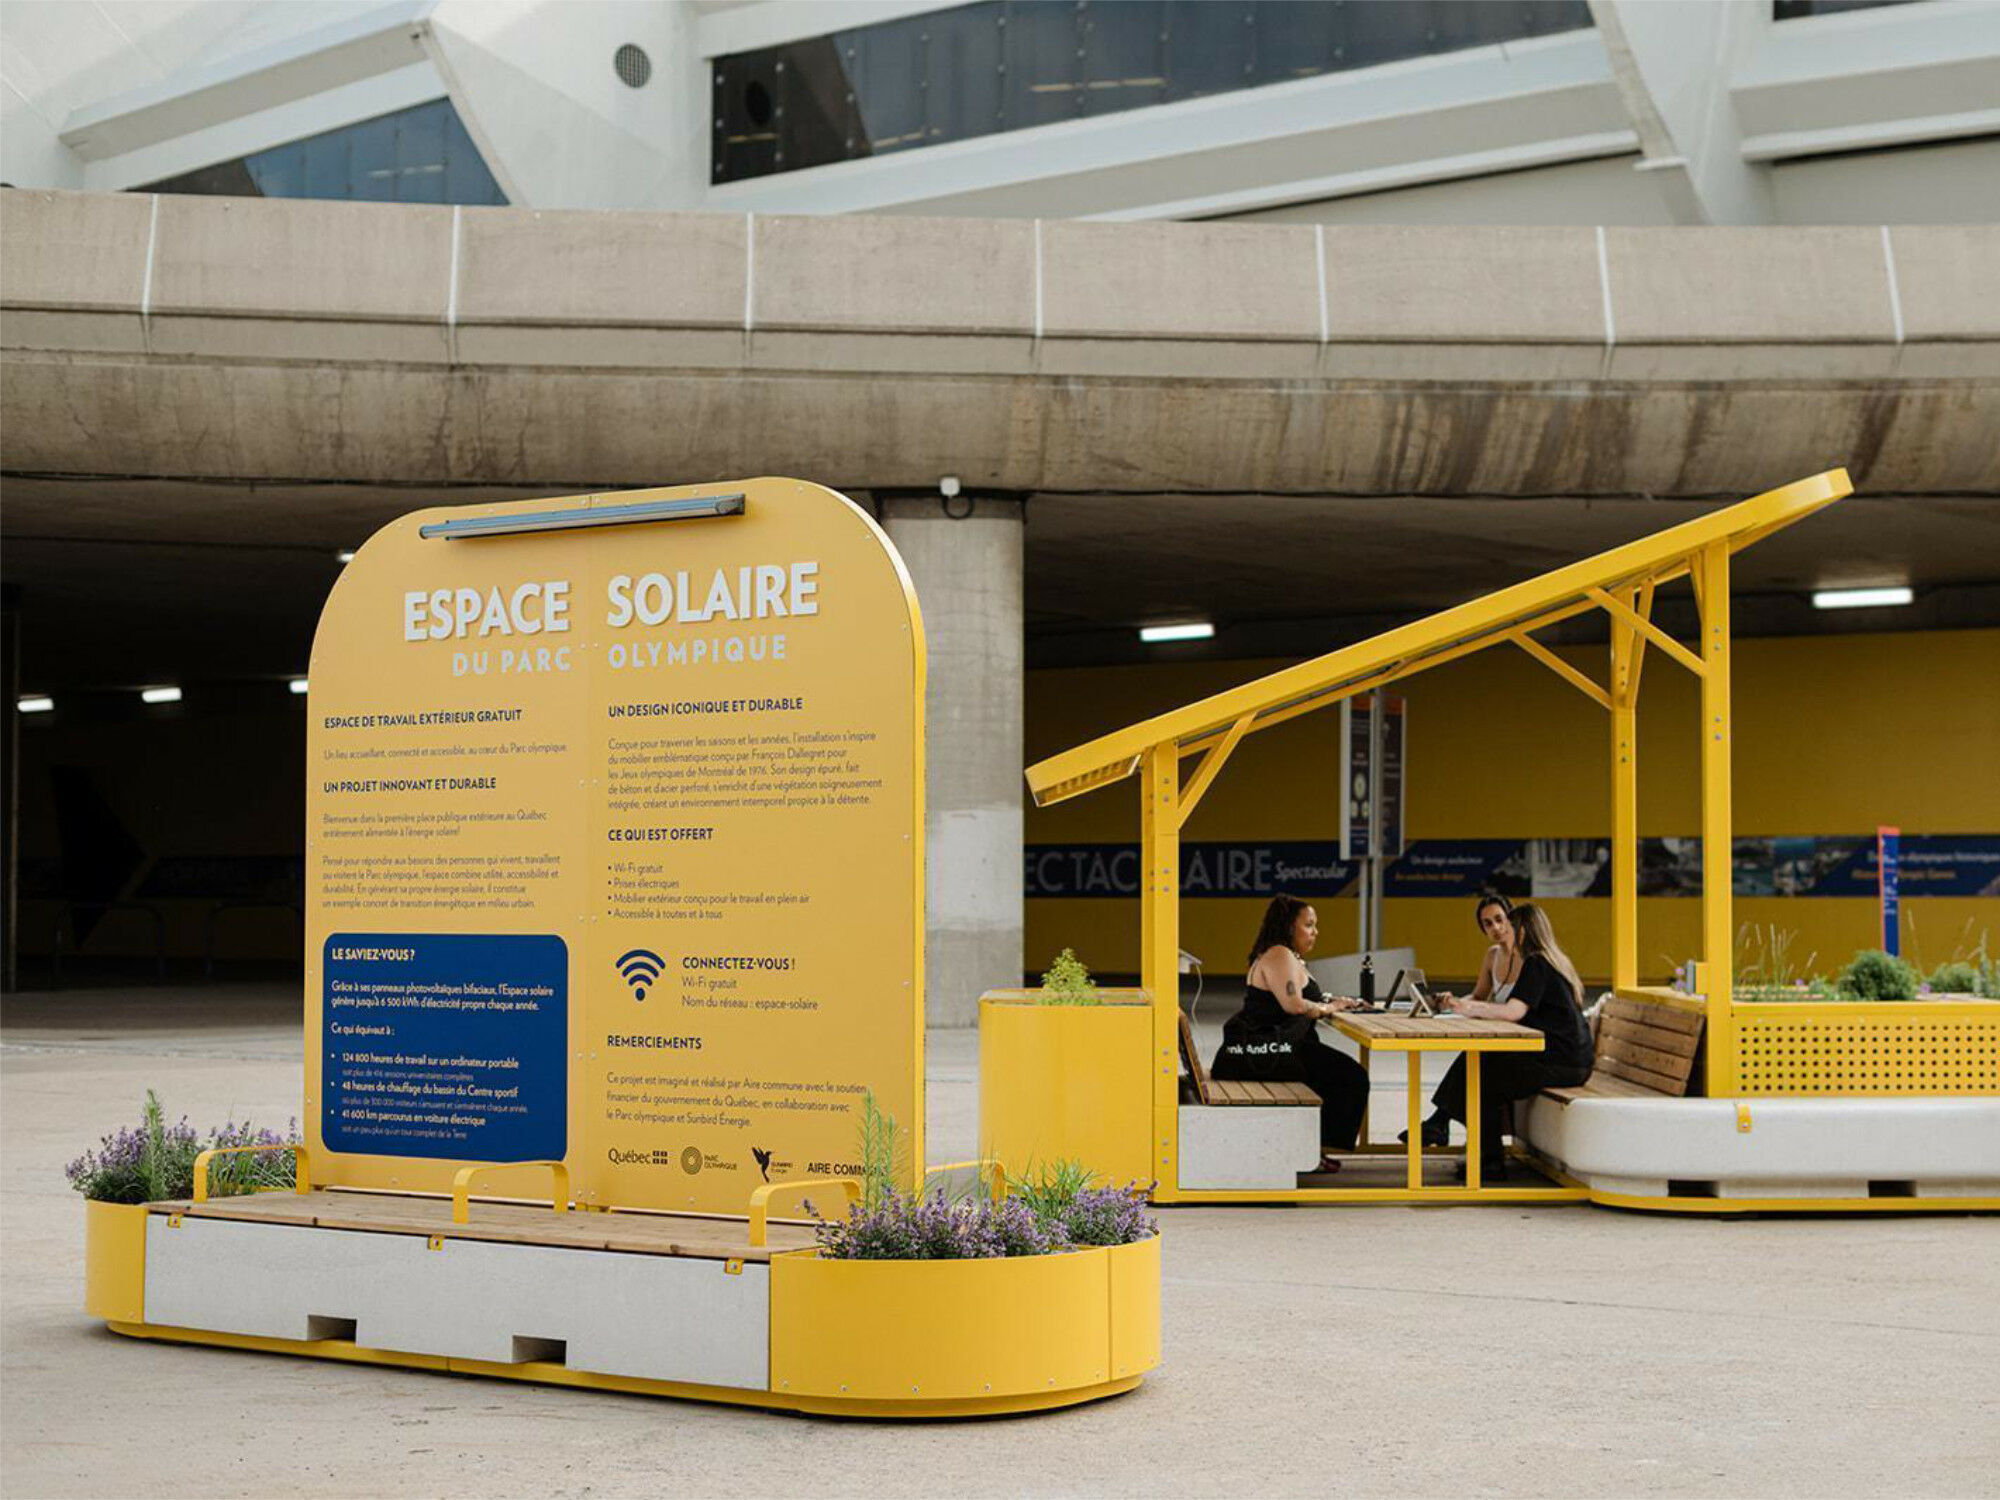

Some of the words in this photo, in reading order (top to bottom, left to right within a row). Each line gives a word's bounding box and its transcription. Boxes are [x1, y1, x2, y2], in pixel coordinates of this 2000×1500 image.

[404, 580, 571, 643] ESPACE
[606, 562, 819, 628] SOLAIRE
[452, 653, 489, 677] DU
[500, 646, 572, 674] PARC
[607, 634, 788, 670] OLYMPIQUE
[608, 705, 625, 717] UN
[627, 703, 669, 717] DESIGN
[671, 701, 729, 715] ICONIQUE
[731, 700, 746, 713] ET
[748, 698, 804, 712] DURABLE
[324, 716, 360, 729] ESPACE
[362, 715, 375, 727] DE
[378, 714, 418, 726] TRAVAIL
[419, 711, 475, 725] EXTÉRIEUR
[477, 709, 523, 723] GRATUIT
[324, 781, 339, 793] UN
[340, 780, 377, 792] PROJET
[379, 779, 433, 792] INNOVANT
[434, 779, 447, 790] ET
[449, 778, 497, 790] DURABLE
[608, 829, 622, 841] CE
[624, 829, 645, 841] QUI
[648, 829, 668, 841] EST
[670, 828, 714, 840] OFFERT
[613, 864, 636, 872] Wi-Fi
[637, 864, 663, 874] gratuit
[1274, 860, 1348, 881] Spectacular
[613, 878, 636, 887] Prises
[637, 878, 680, 889] électriques
[613, 894, 647, 903] Mobilier
[648, 894, 681, 903] extérieur
[683, 896, 709, 905] conçu
[709, 896, 730, 905] pour
[739, 894, 764, 903] travail
[777, 894, 797, 905] plein
[799, 894, 810, 903] air
[613, 909, 655, 919] Accessible
[663, 909, 686, 919] toutes
[688, 909, 697, 919] et
[706, 909, 722, 919] tous
[331, 948, 344, 960] LE
[345, 948, 409, 961] SAVIEZ-VOUS
[409, 949, 415, 961] ?
[682, 957, 790, 970] CONNECTEZ-VOUS
[791, 957, 796, 970] !
[682, 977, 707, 988] Wi-Fi
[708, 977, 737, 990] gratuit
[682, 997, 703, 1007] Nom
[704, 997, 718, 1007] du
[720, 998, 748, 1008] réseau
[755, 999, 819, 1011] espace-solaire
[607, 1035, 702, 1049] REMERCIEMENTS
[1246, 1043, 1268, 1054] And
[606, 1073, 619, 1083] Ce
[620, 1073, 643, 1086] projet
[644, 1074, 656, 1084] est
[658, 1074, 689, 1087] imaginé
[690, 1075, 699, 1086] et
[701, 1075, 726, 1086] réalisé
[727, 1079, 741, 1089] par
[743, 1077, 760, 1088] Aire
[761, 1080, 803, 1089] commune
[805, 1081, 824, 1090] avec
[835, 1080, 867, 1091] soutien
[606, 1092, 639, 1103] financier
[640, 1094, 651, 1104] du
[653, 1094, 710, 1108] gouvernement
[712, 1096, 723, 1106] du
[724, 1097, 759, 1110] Québec,
[761, 1100, 773, 1108] en
[775, 1098, 828, 1110] collaboration
[830, 1103, 850, 1111] avec
[615, 1110, 632, 1121] Parc
[633, 1111, 675, 1125] olympique
[676, 1112, 685, 1123] et
[686, 1113, 717, 1124] Sunbird
[719, 1114, 752, 1128] Énergie.
[608, 1147, 651, 1165] Québec
[807, 1162, 831, 1175] AIRE
